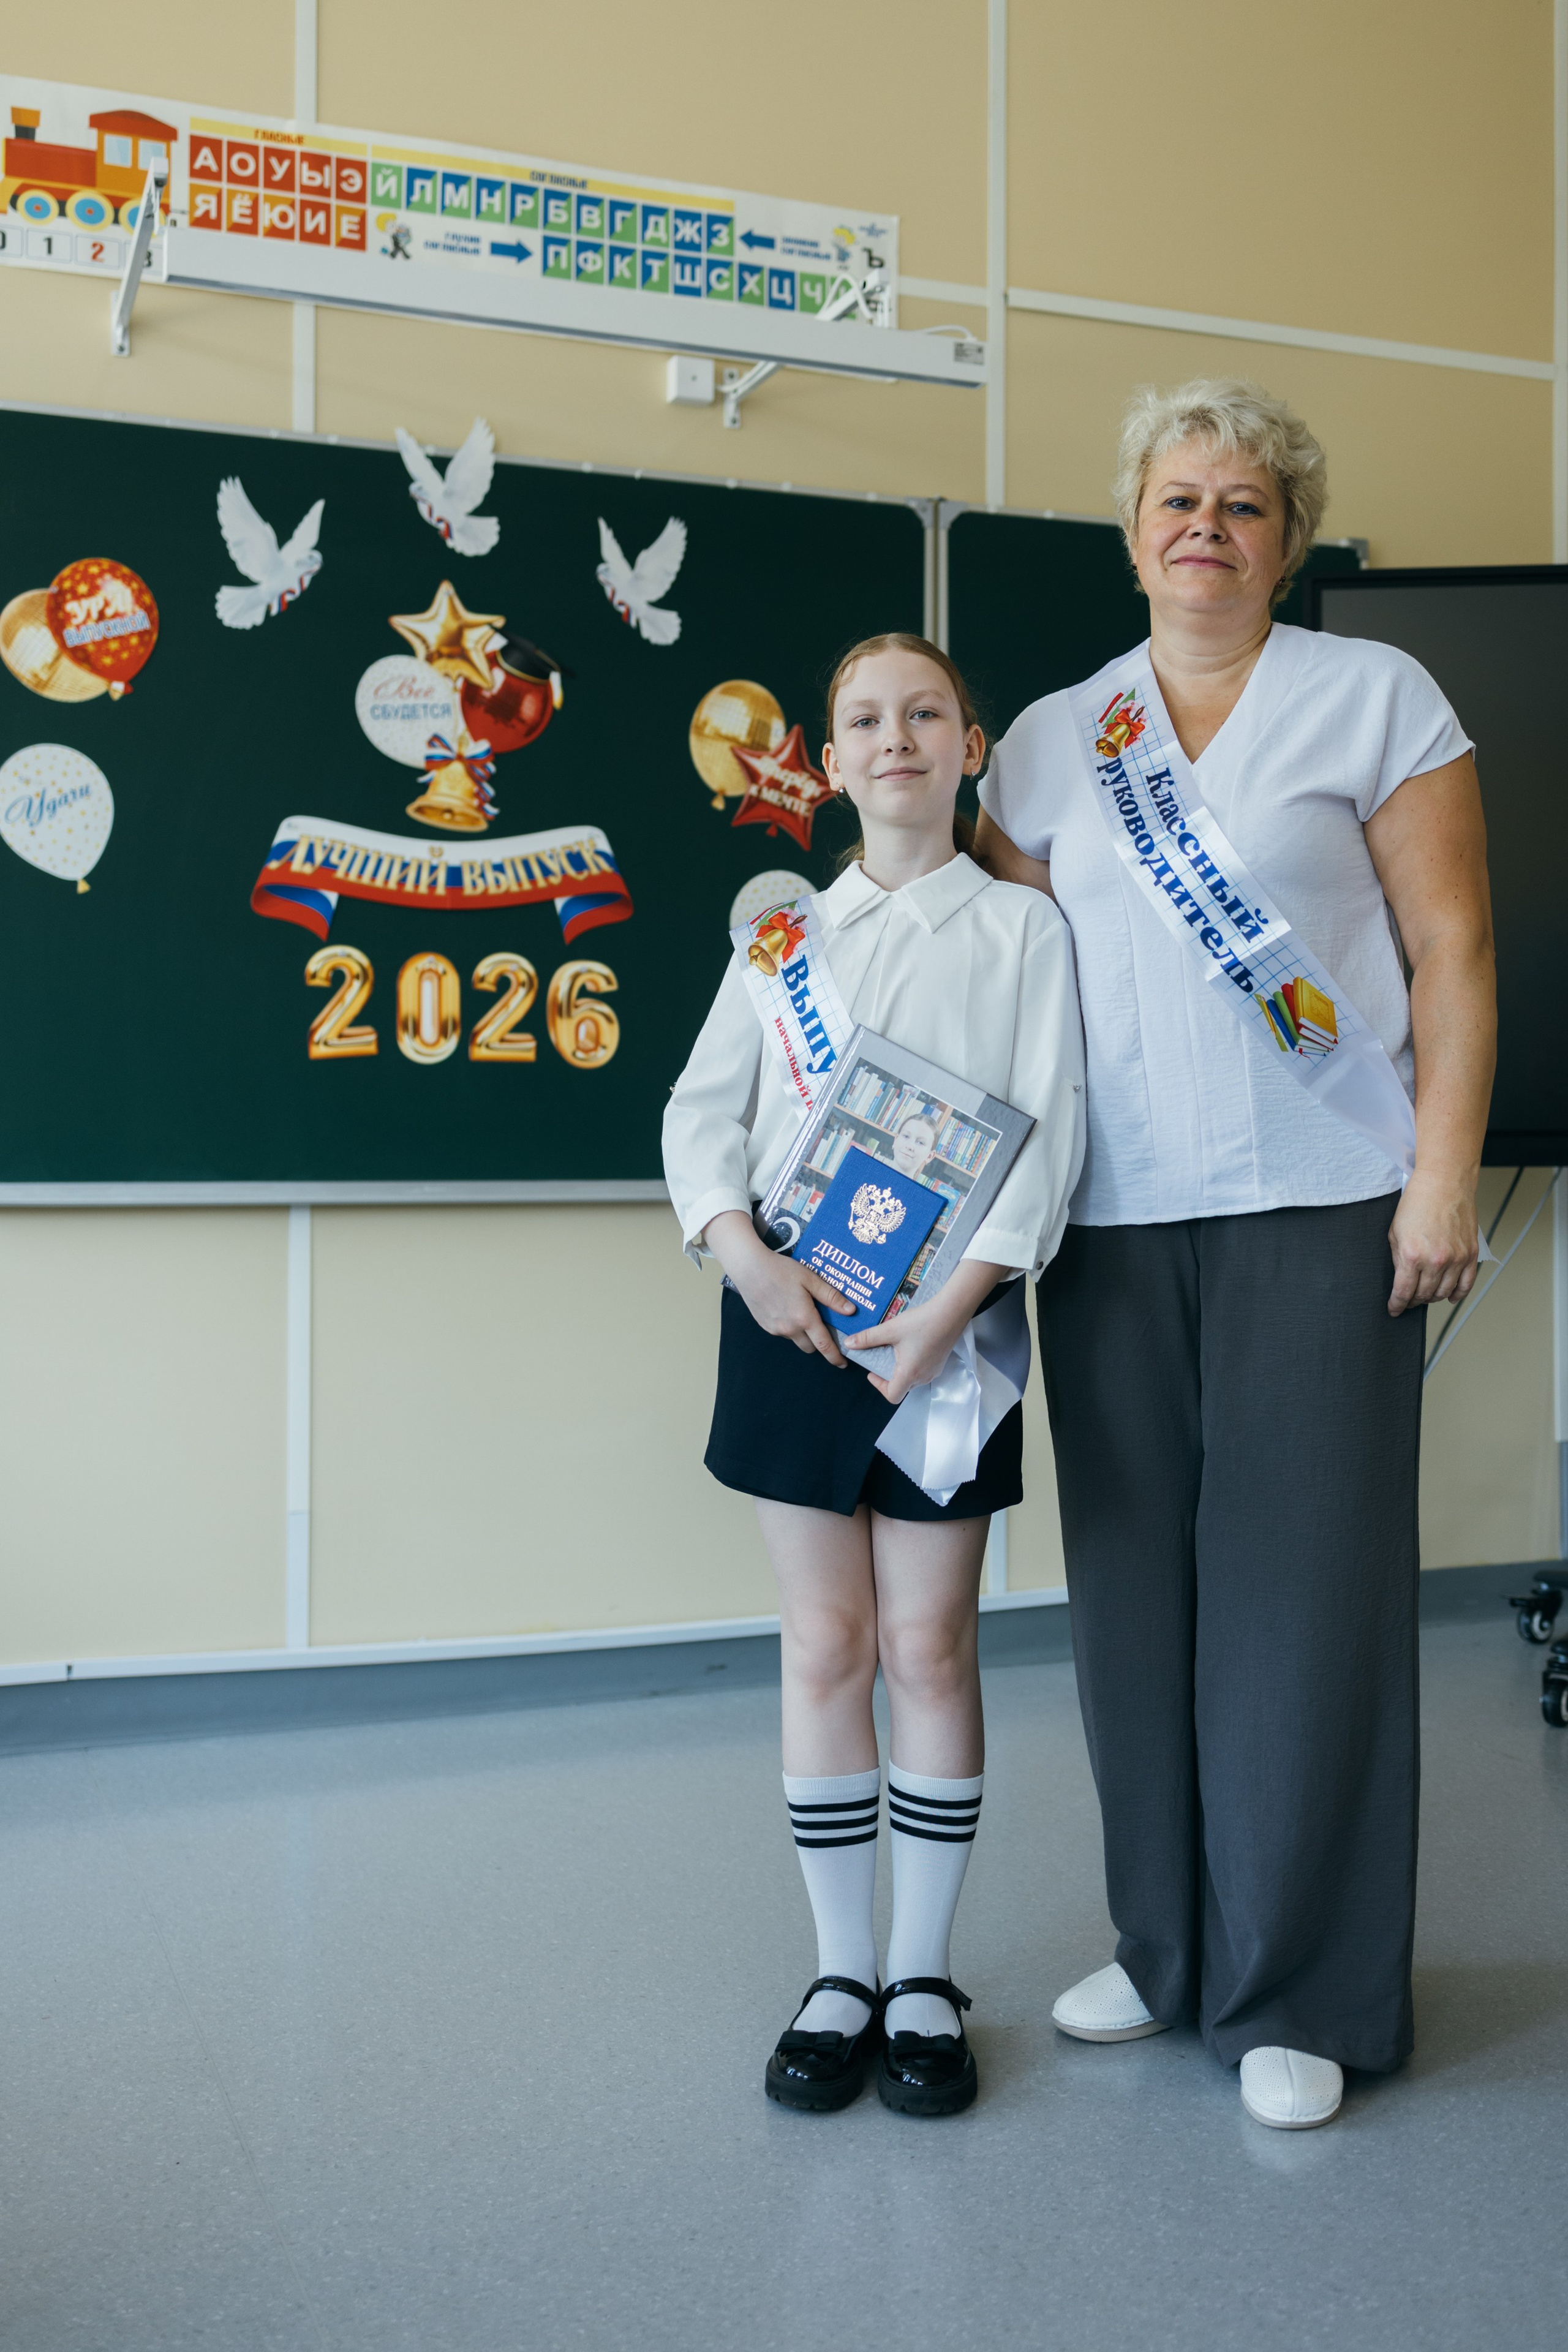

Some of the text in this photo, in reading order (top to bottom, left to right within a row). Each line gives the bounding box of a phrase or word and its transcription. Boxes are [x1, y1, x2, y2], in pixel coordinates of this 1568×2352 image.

[193, 146, 363, 193] А О У Ы Э
[194, 193, 361, 240] Я Ё Ю И Е
[376, 167, 729, 247] Й Л М Н Р Б В Г Д Ж З
[43, 236, 53, 255] 1
[91, 241, 105, 263] 2
[862, 247, 884, 268] Ъ
[548, 244, 568, 269] П
[577, 250, 603, 273] Ф
[614, 254, 631, 279] К
[646, 258, 665, 282] Т
[674, 262, 701, 288] Ш
[709, 267, 729, 290] С
[742, 271, 761, 296] Х
[771, 276, 793, 305] Ц
[804, 281, 823, 305] Ч
[63, 609, 151, 648] ВЫПУСКНОЙ
[373, 675, 435, 699] Все
[369, 703, 452, 721] СБУДЕТСЯ
[761, 786, 810, 817] МЕЧТЕ
[268, 834, 614, 897] ЛУЧШИЙ ВЫПУСК
[1096, 757, 1254, 993] руководитель
[1145, 767, 1269, 944] Классный
[305, 945, 620, 1069] 2026
[774, 1017, 812, 1099] начальной
[812, 1239, 884, 1289] ДИПЛОМ
[812, 1256, 872, 1297] ОБ ОКОНЧАНИИ
[845, 1288, 876, 1311] ШКОЛЫ
